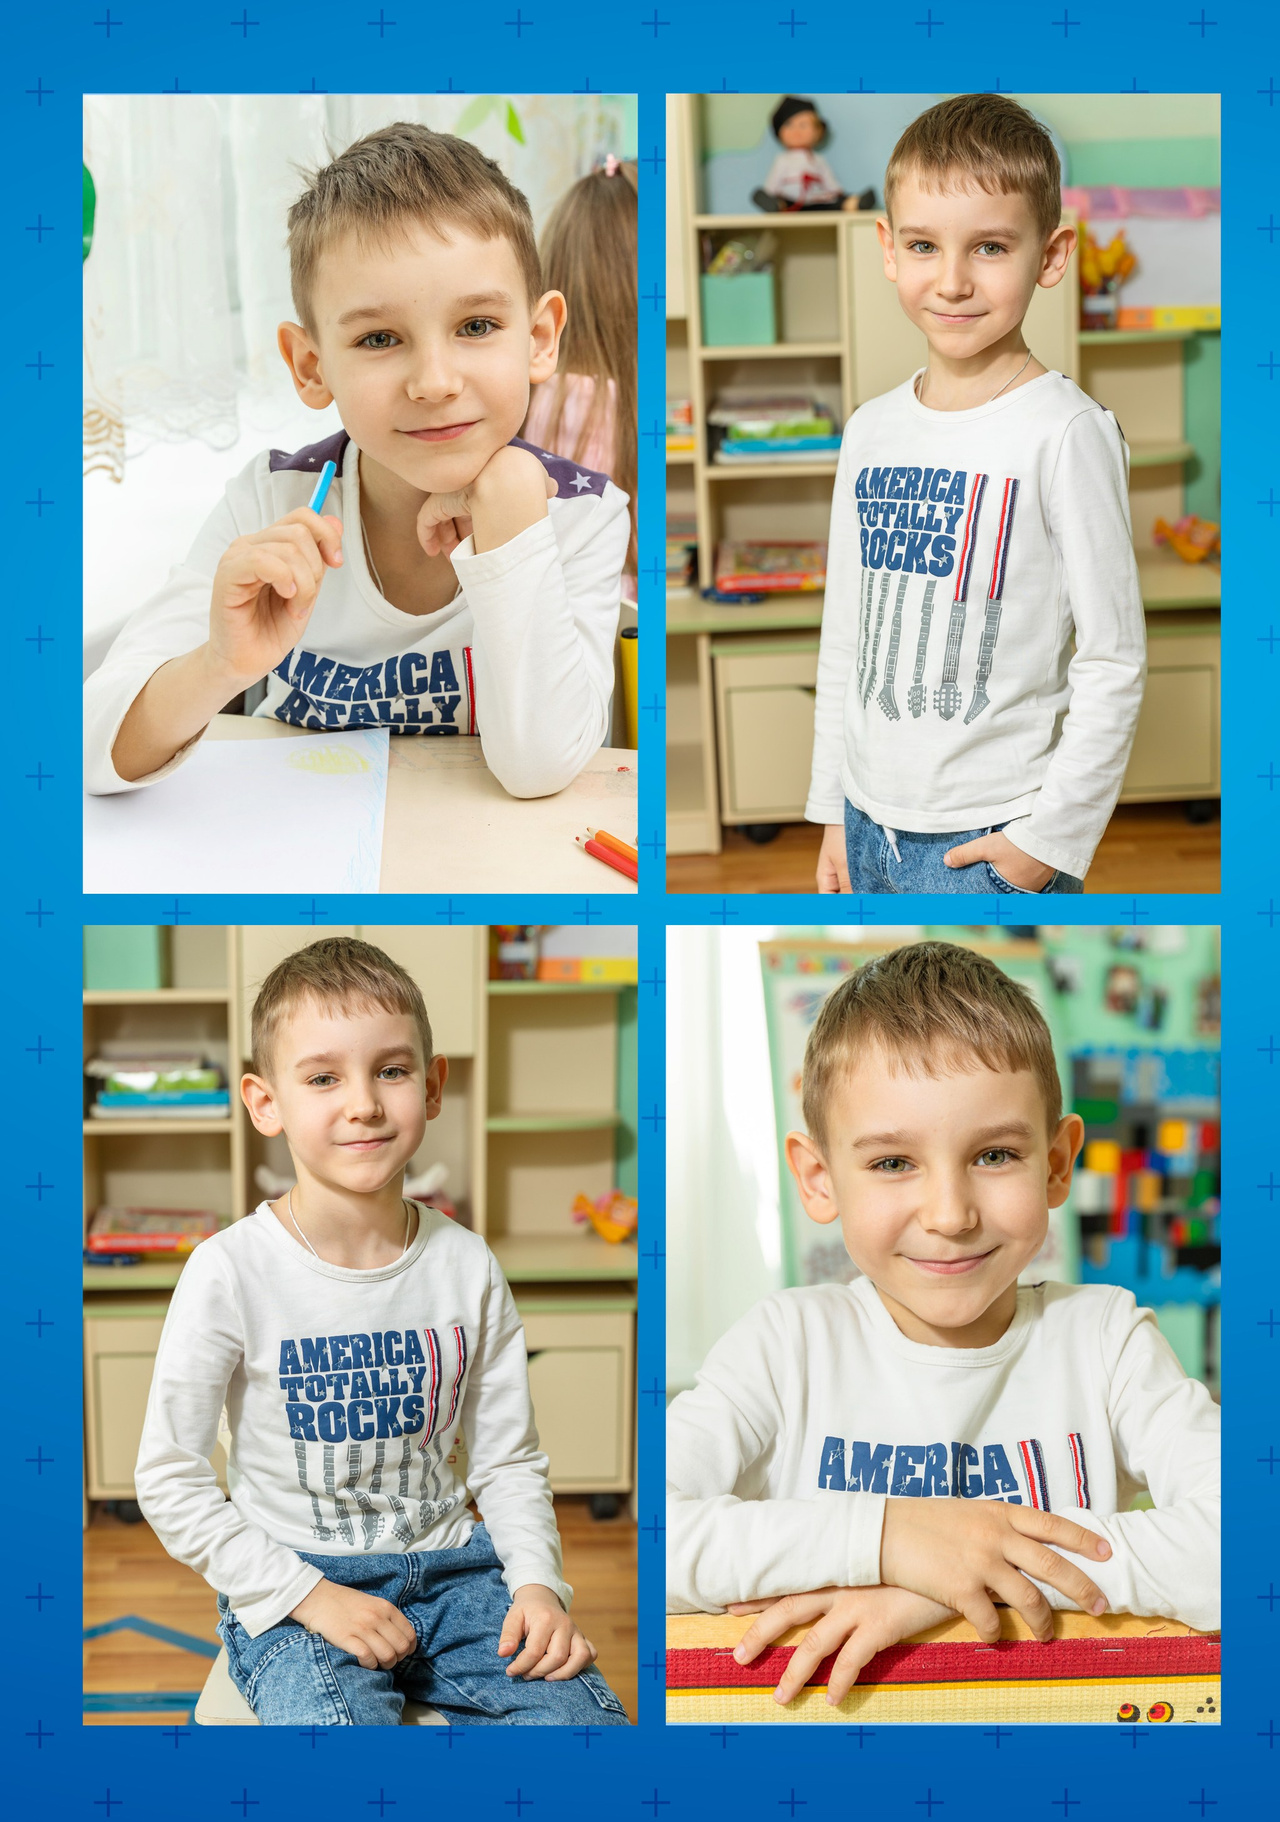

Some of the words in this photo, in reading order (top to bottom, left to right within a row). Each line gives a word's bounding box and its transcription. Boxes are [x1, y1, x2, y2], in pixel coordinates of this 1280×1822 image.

[855, 466, 967, 505] AMERICA
[857, 500, 964, 535] TOTALLY
[860, 528, 957, 577] ROCKS
[279, 1329, 425, 1375] AMERICA
[279, 1366, 426, 1402] TOTALLY
[285, 1395, 425, 1443] ROCKS
[817, 1436, 1020, 1498] AMERICA
